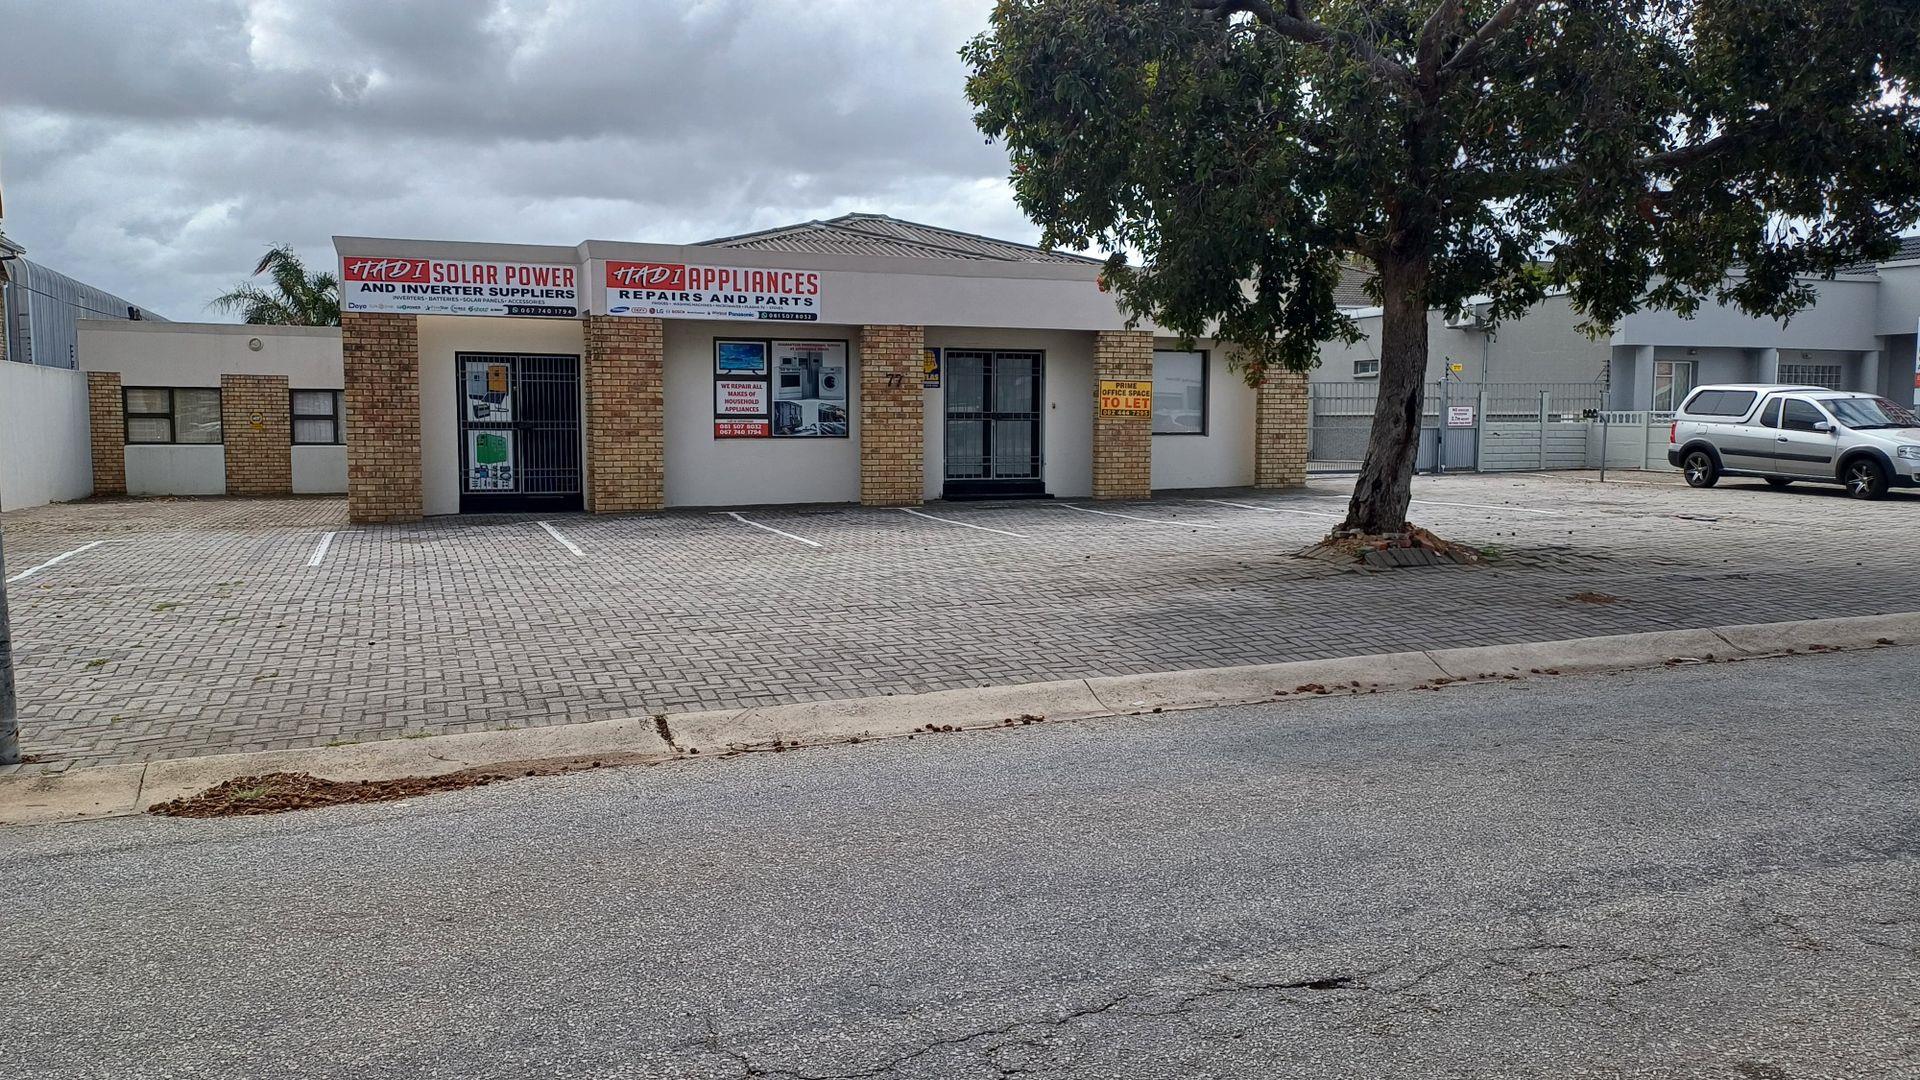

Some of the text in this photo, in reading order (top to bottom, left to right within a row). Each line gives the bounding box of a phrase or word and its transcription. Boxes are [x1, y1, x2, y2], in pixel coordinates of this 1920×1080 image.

[433, 263, 498, 284] SOLAR
[505, 266, 575, 287] POWER
[688, 268, 818, 294] APPLIANCES
[360, 283, 575, 299] AND INVERTER SUPPLIERS
[619, 290, 813, 307] REPAIRS AND PARTS
[886, 374, 903, 387] 77
[1102, 397, 1149, 408] TO LET
